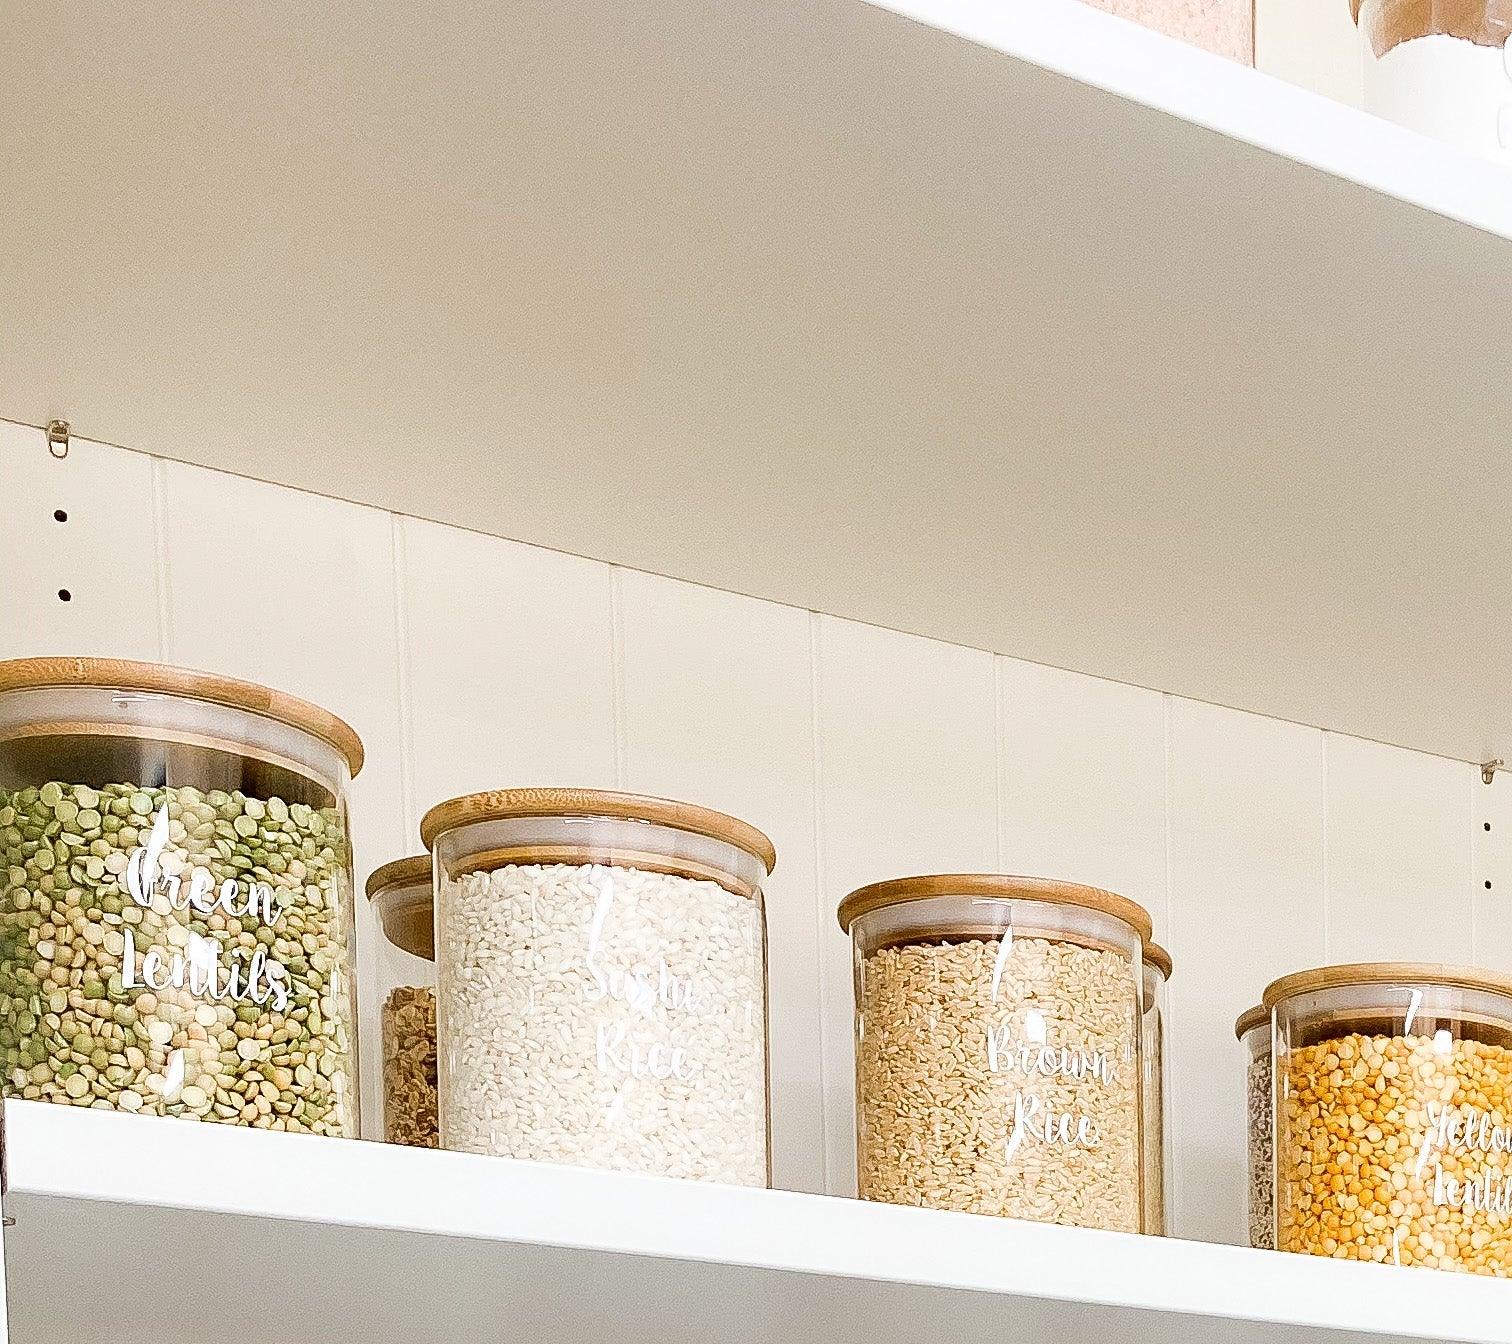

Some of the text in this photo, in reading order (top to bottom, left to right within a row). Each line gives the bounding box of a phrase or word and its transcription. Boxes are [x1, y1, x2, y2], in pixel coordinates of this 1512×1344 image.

[125, 842, 284, 928] Green
[121, 930, 293, 1014] Lentils
[986, 1012, 1115, 1086] Brown
[1009, 1086, 1101, 1148] Rice
